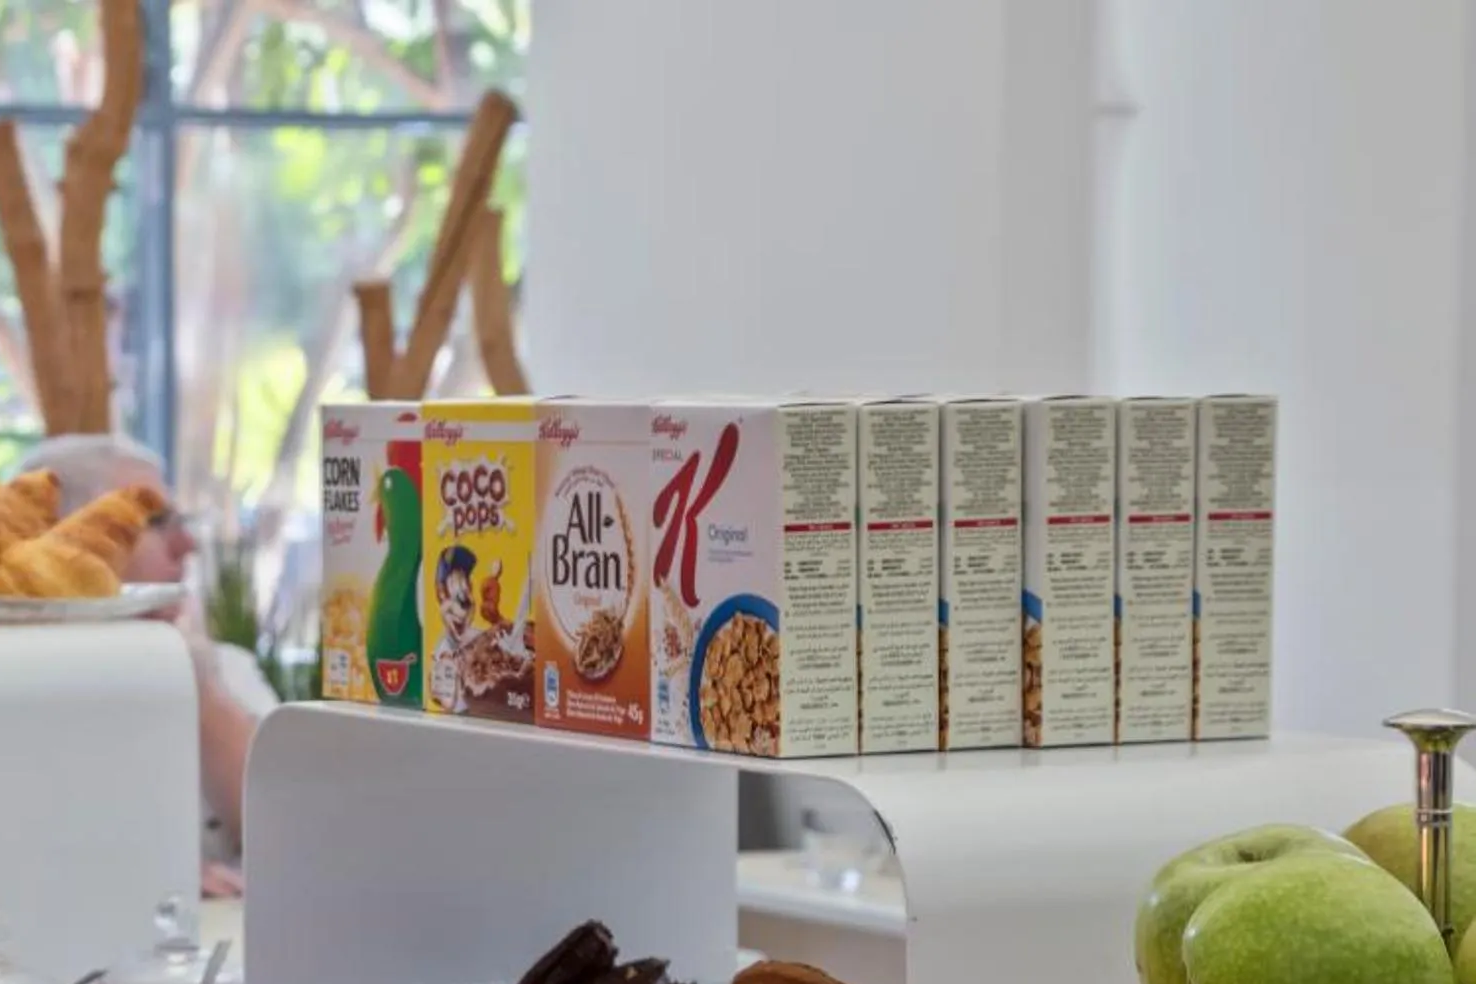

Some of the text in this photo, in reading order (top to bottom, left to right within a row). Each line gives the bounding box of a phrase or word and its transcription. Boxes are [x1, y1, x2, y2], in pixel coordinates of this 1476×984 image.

[324, 456, 360, 486] CORN
[324, 491, 359, 512] FLAKES
[653, 422, 739, 607] K
[708, 524, 748, 546] Original
[552, 534, 621, 590] Bran
